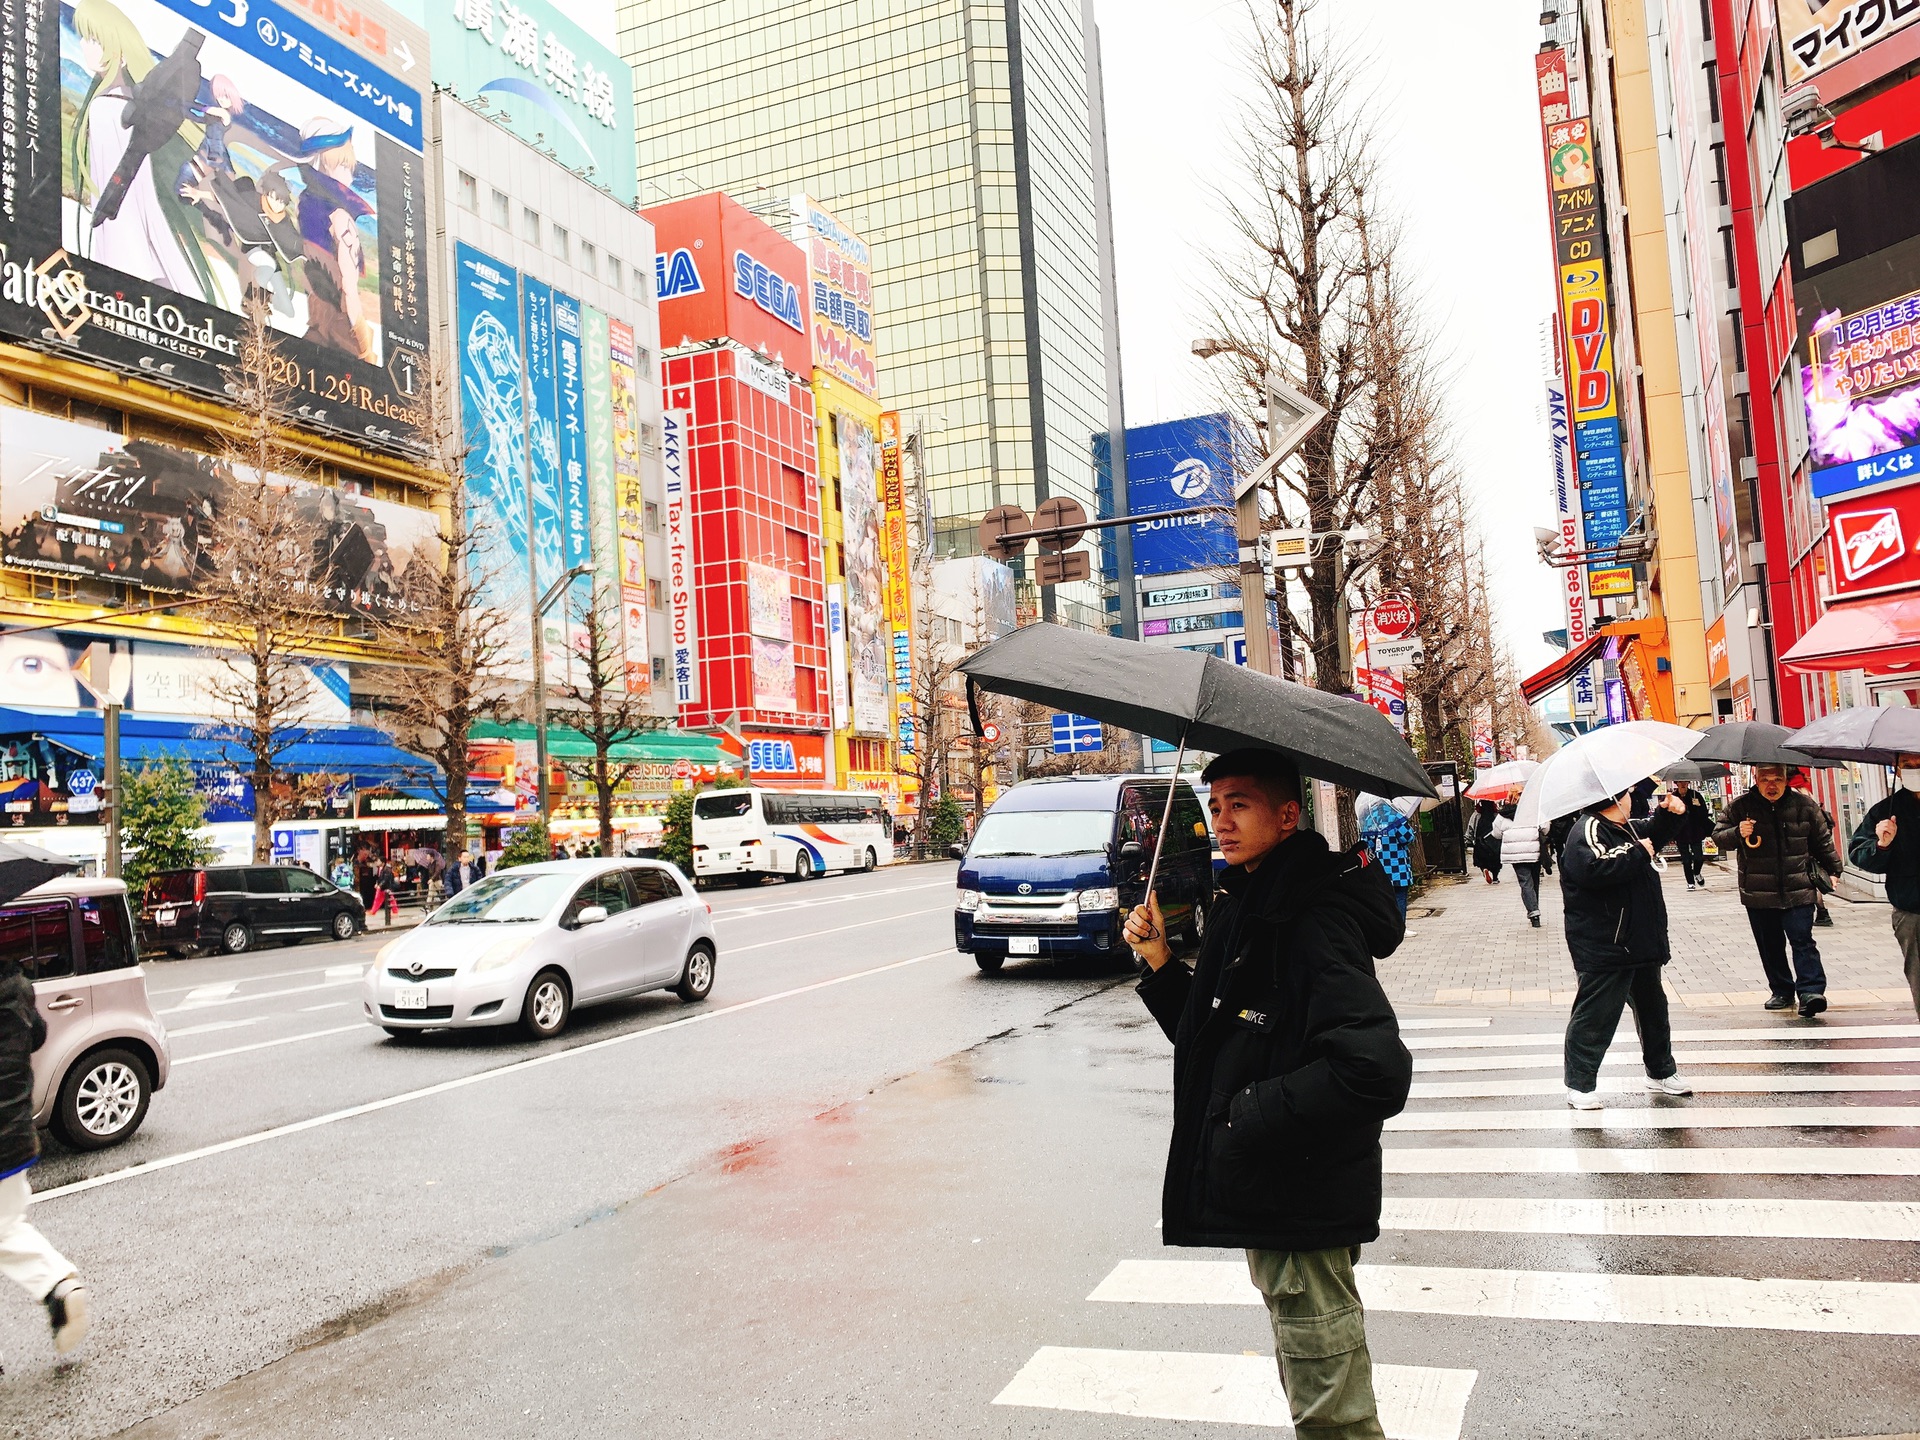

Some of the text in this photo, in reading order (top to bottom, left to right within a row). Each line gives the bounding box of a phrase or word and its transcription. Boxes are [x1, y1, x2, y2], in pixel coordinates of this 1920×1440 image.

[1540, 71, 1570, 124] 曲数
[1551, 122, 1587, 148] 激安
[1557, 188, 1595, 212] アイドル
[1560, 213, 1595, 236] アニメ
[1569, 240, 1591, 260] CD
[812, 239, 870, 304] 激安販売
[734, 250, 804, 335] SEGA
[1567, 288, 1588, 296] Blu-ray
[813, 281, 871, 342] 高額買取
[153, 304, 240, 356] Order
[539, 296, 550, 379] ゲームセンターを
[1569, 298, 1611, 412] DVD
[401, 365, 414, 395] 1
[359, 385, 427, 429] Release
[1548, 387, 1569, 446] AKKY
[562, 339, 586, 555] 電子マネー使えます
[663, 415, 680, 478] AKKY
[1583, 434, 1613, 442] マニアレーベル
[1584, 440, 1614, 449] インディーズ各社
[1553, 439, 1569, 514] INTERNATIONAL
[1586, 464, 1616, 472] マニアレーベル
[1587, 470, 1617, 479] インディーズ各社
[1857, 453, 1914, 482] 詳しくは
[1590, 499, 1620, 508] マニアレーベル
[55, 528, 112, 550] 配信開始
[668, 497, 686, 587] Tax-free
[1851, 526, 1896, 547] ADORES
[673, 592, 689, 645] Shop
[829, 602, 842, 634] SEGA
[1376, 609, 1408, 627] 消火栓
[1569, 595, 1585, 642] Shop
[1377, 645, 1415, 655] TOYGROUP
[675, 648, 691, 683] 愛客
[986, 728, 996, 738] 50
[643, 763, 672, 779] Shop
[749, 740, 797, 773] SEGA
[799, 755, 823, 773] 3号館
[71, 776, 93, 788] 437
[401, 996, 425, 1007] 51-45
